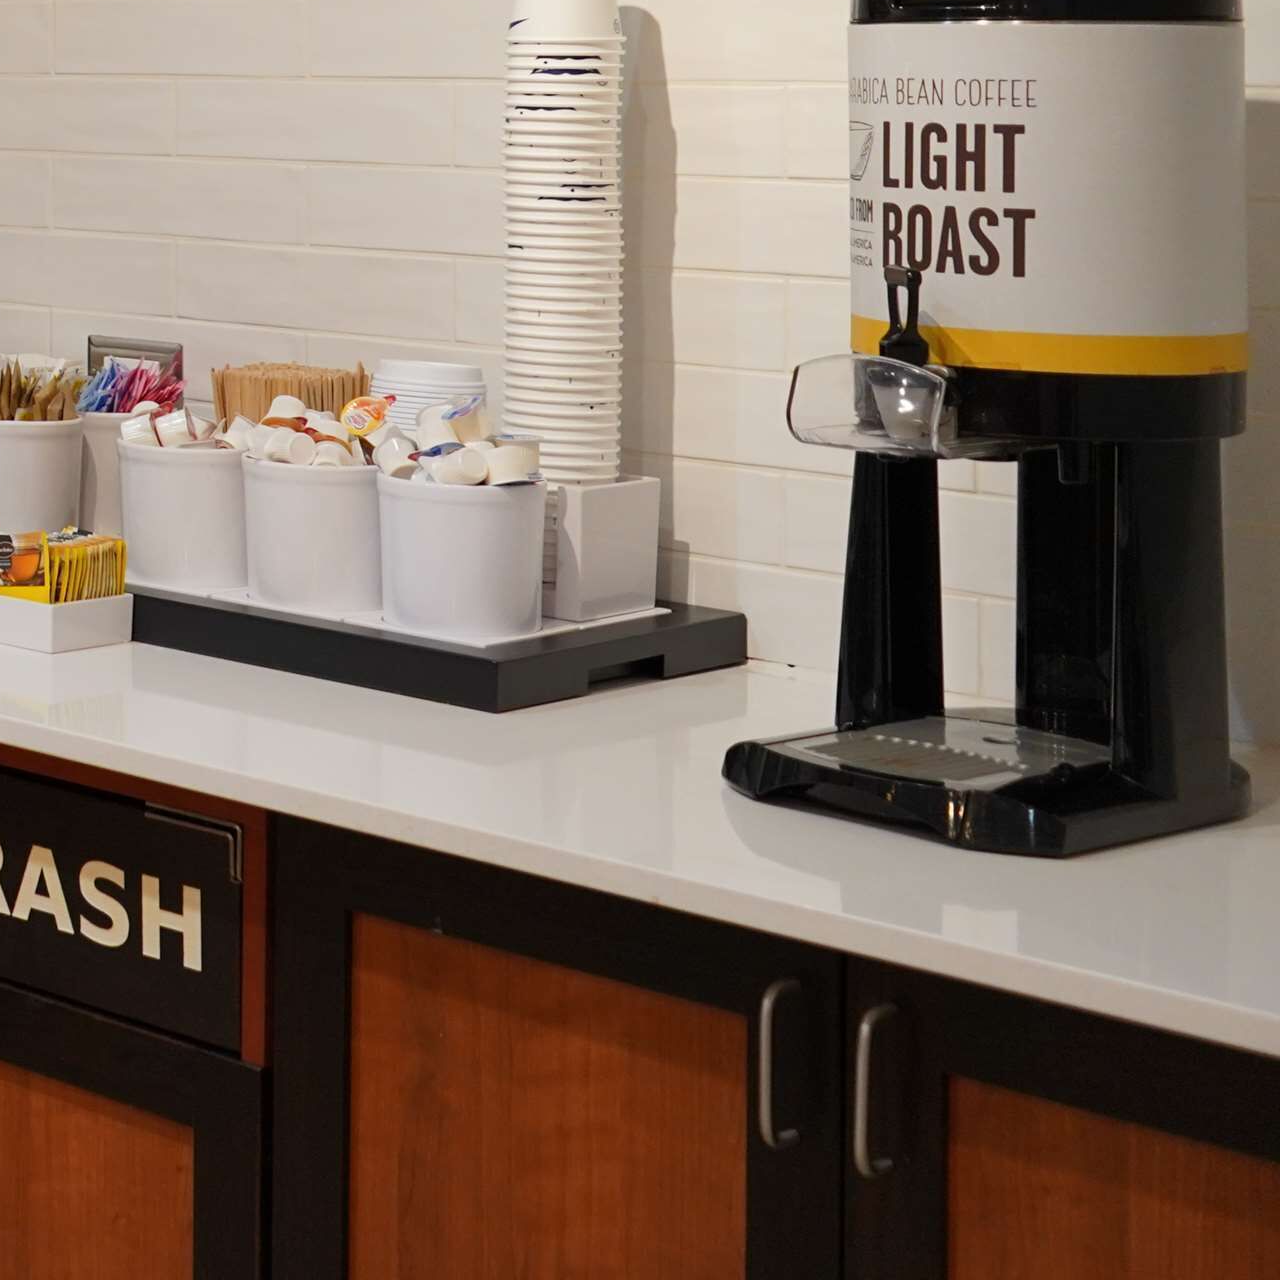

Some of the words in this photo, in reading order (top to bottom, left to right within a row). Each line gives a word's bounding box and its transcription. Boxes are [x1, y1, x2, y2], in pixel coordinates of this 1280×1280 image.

[895, 77, 944, 106] BEAN
[954, 78, 1038, 108] COFFEE
[882, 121, 1025, 193] LIGHT
[856, 198, 873, 223] FROM
[882, 202, 1036, 277] ROAST
